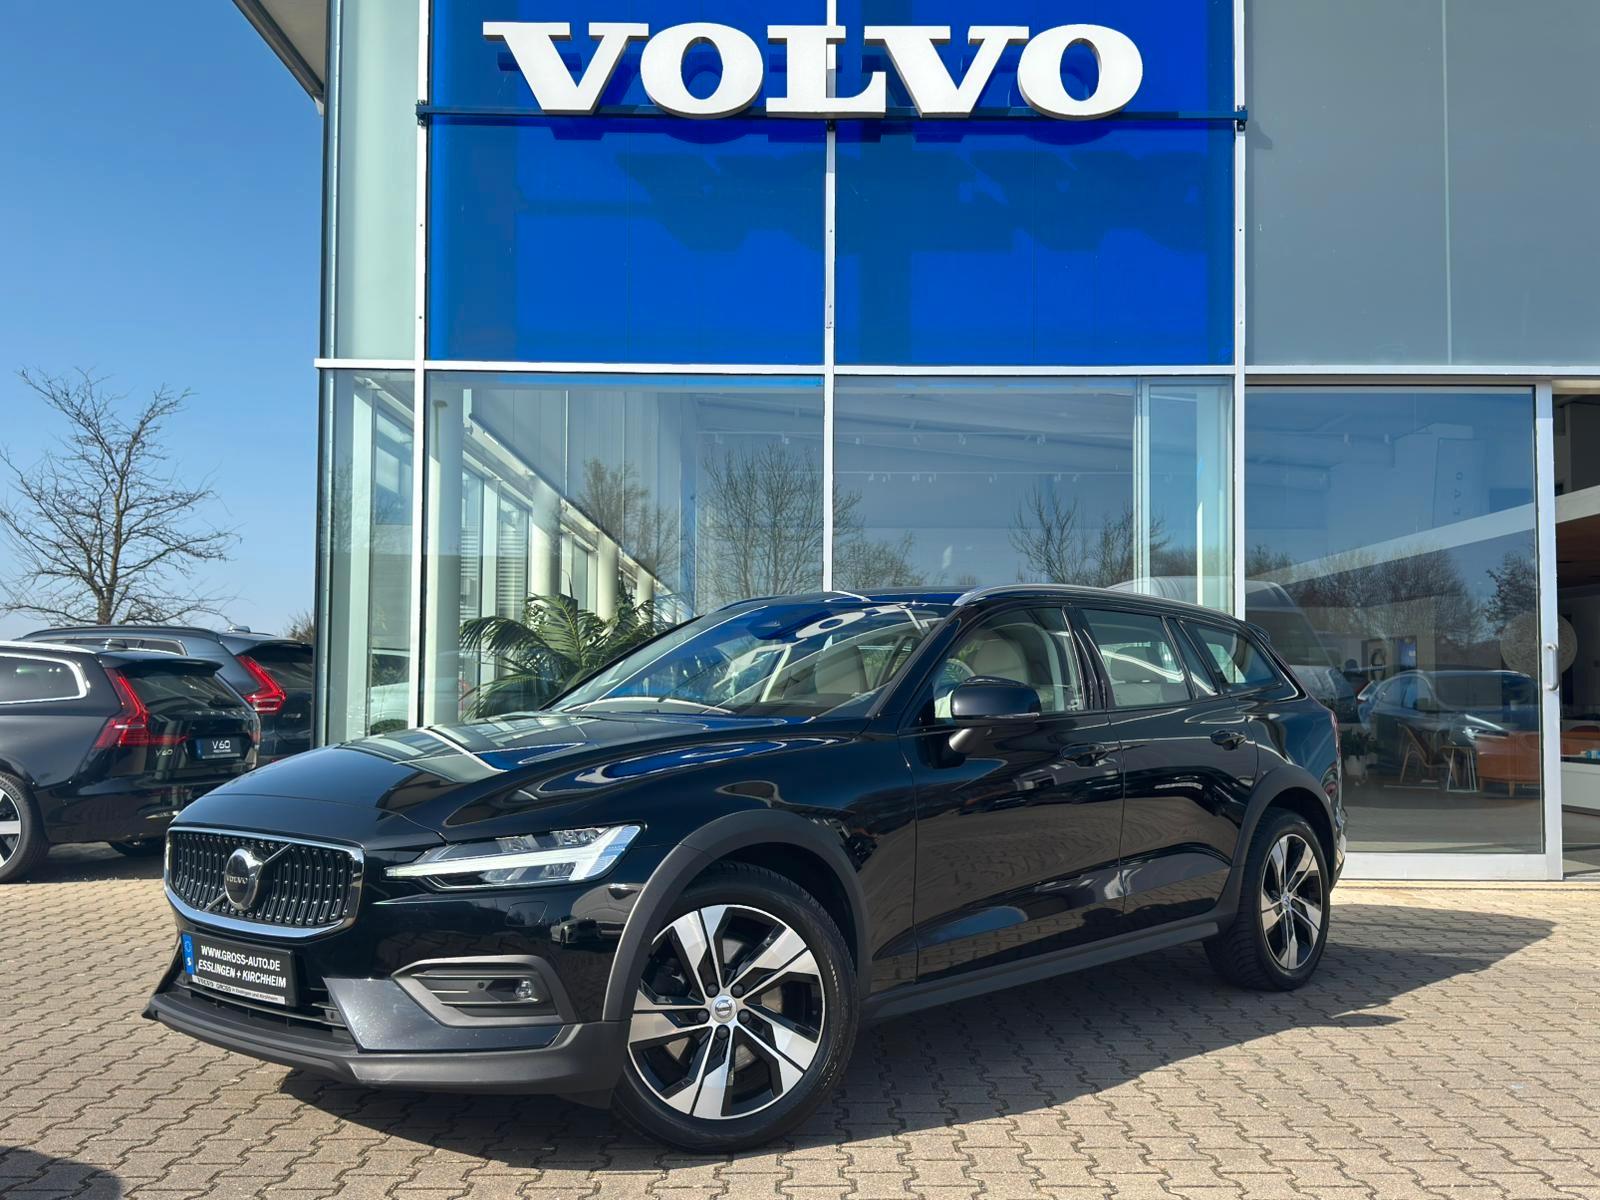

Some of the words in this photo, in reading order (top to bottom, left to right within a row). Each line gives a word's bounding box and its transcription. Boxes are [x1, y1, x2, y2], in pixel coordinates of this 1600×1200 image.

[482, 22, 1143, 119] VOLVO
[212, 740, 231, 749] V60
[201, 944, 281, 971] WWW.GROSS-AUTO.DE
[198, 959, 235, 978] ESSLINGEN
[242, 969, 287, 989] KIRCHHEIM
